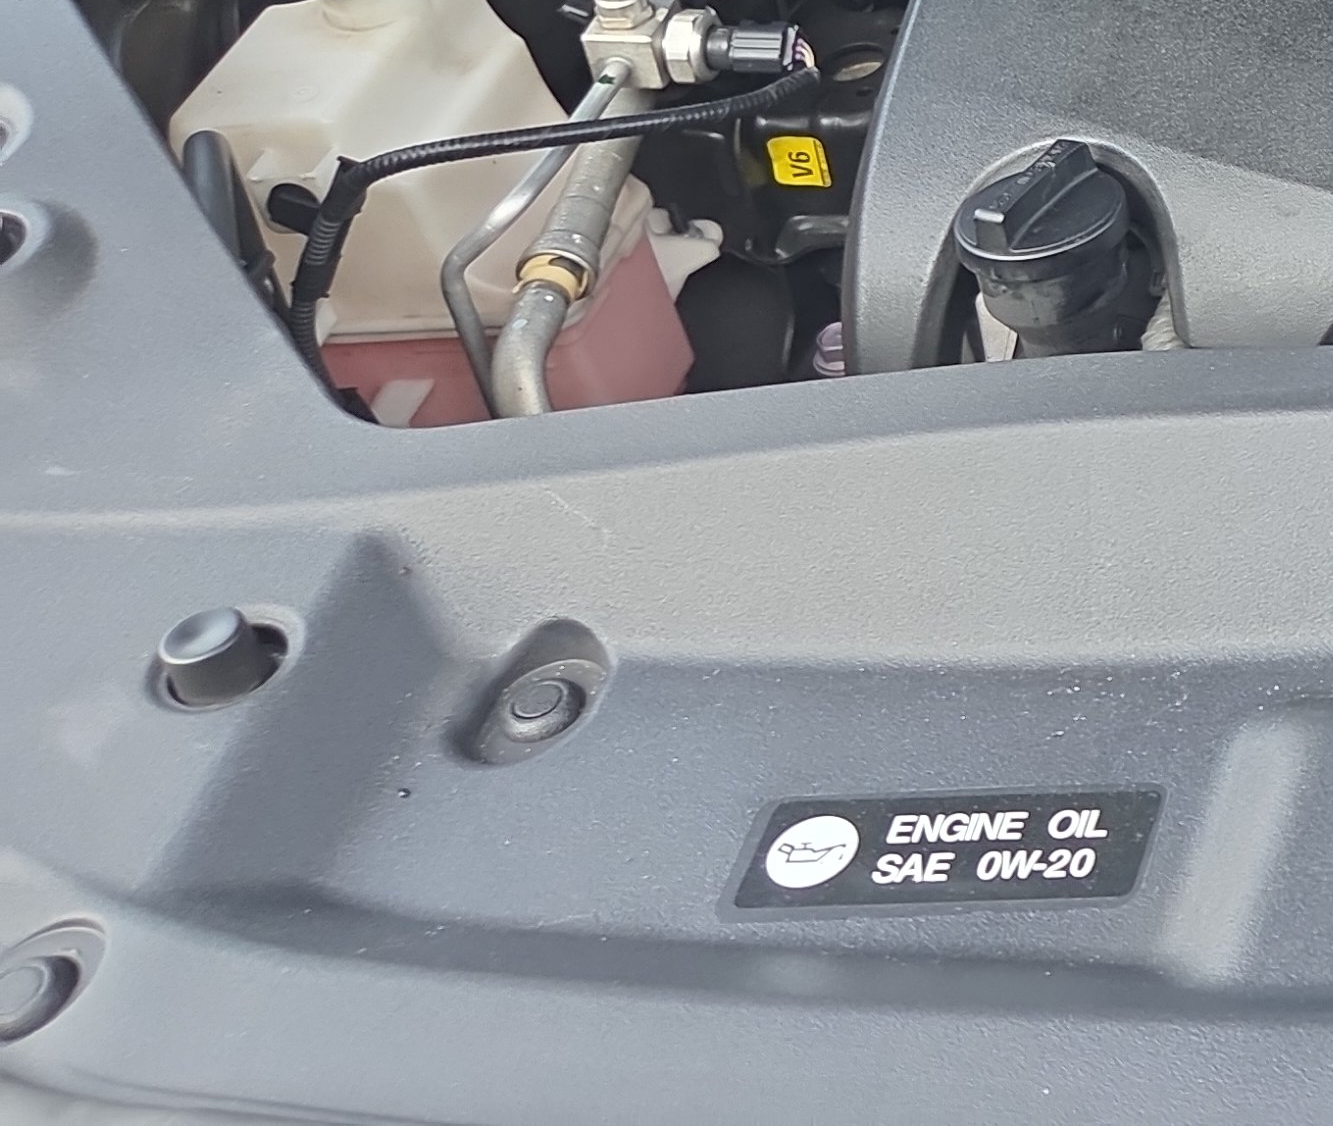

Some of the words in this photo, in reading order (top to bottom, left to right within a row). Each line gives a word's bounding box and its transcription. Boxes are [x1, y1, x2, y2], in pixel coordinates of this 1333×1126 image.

[787, 151, 814, 178] V6
[886, 811, 1029, 844] ENGINE
[1047, 809, 1108, 839] OIL
[871, 852, 956, 884] SAE
[976, 848, 1096, 881] 0W-20
